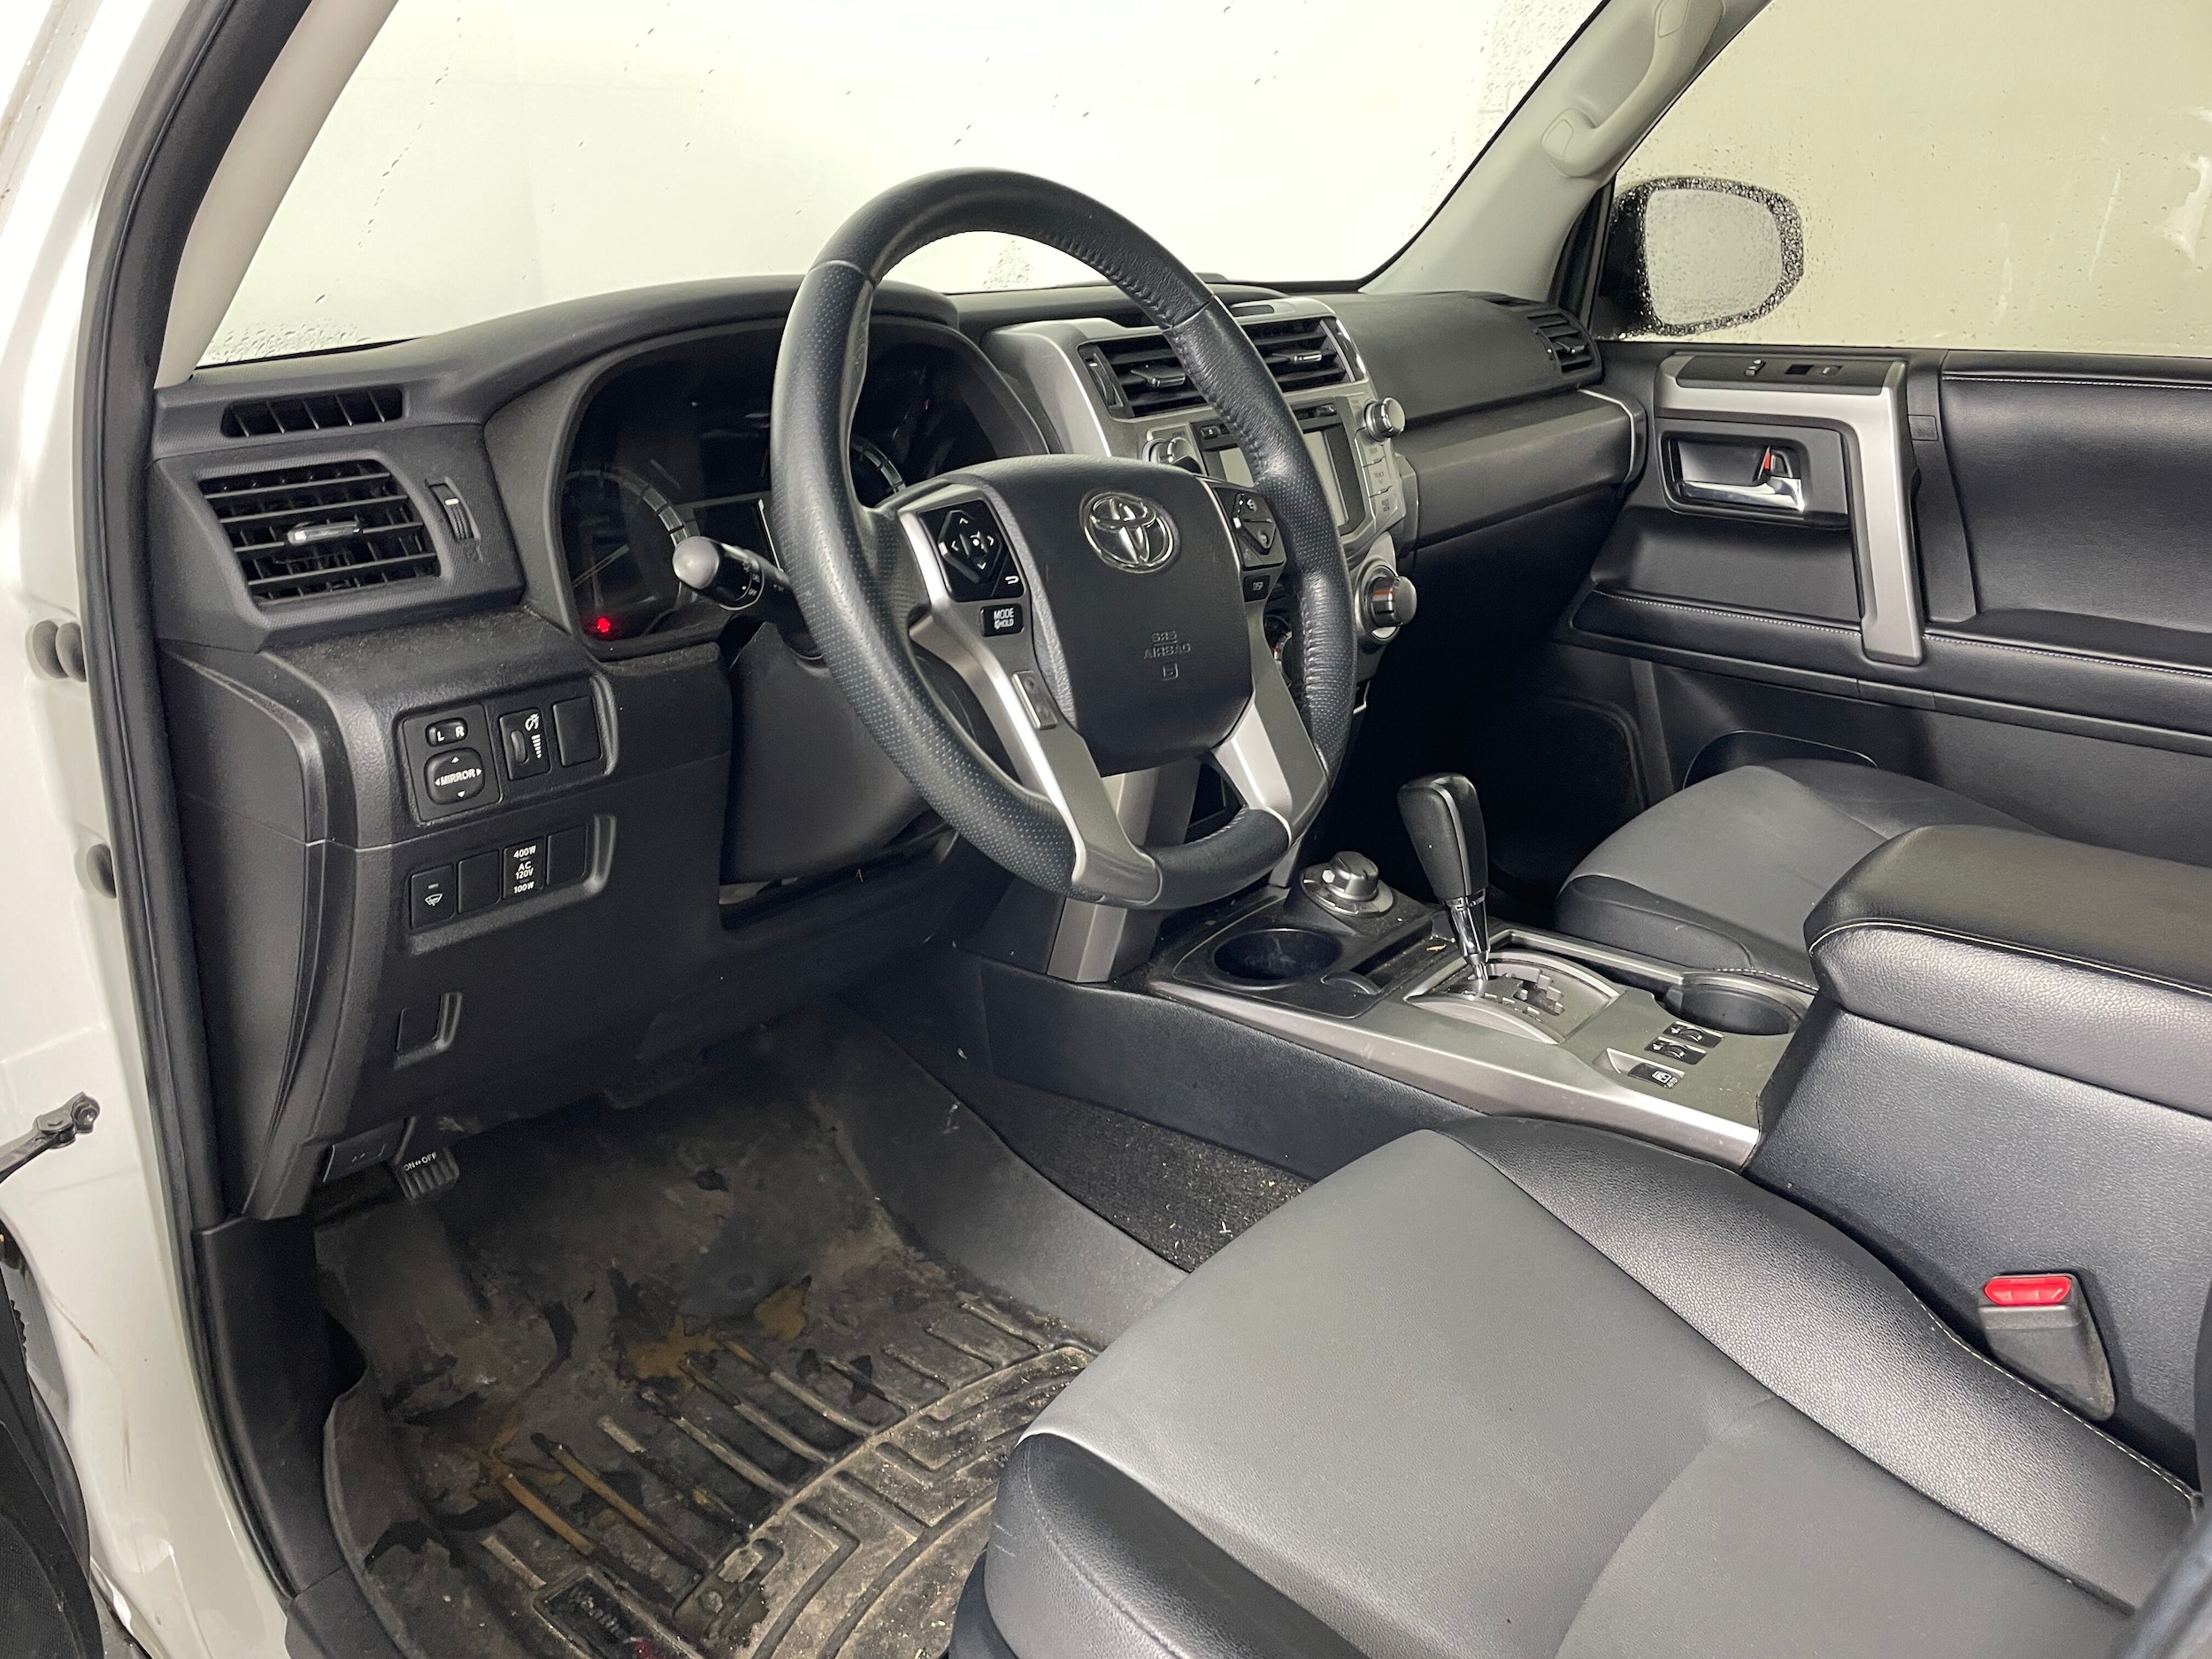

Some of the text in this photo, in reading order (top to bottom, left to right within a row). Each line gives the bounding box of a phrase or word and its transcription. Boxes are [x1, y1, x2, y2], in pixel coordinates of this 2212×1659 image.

[994, 607, 1014, 619] MODE
[437, 726, 465, 741] L R
[441, 768, 476, 786] MIRROR
[513, 844, 537, 858] 400W
[515, 867, 534, 879] 120V
[518, 860, 532, 872] AC
[513, 880, 535, 894] 100W
